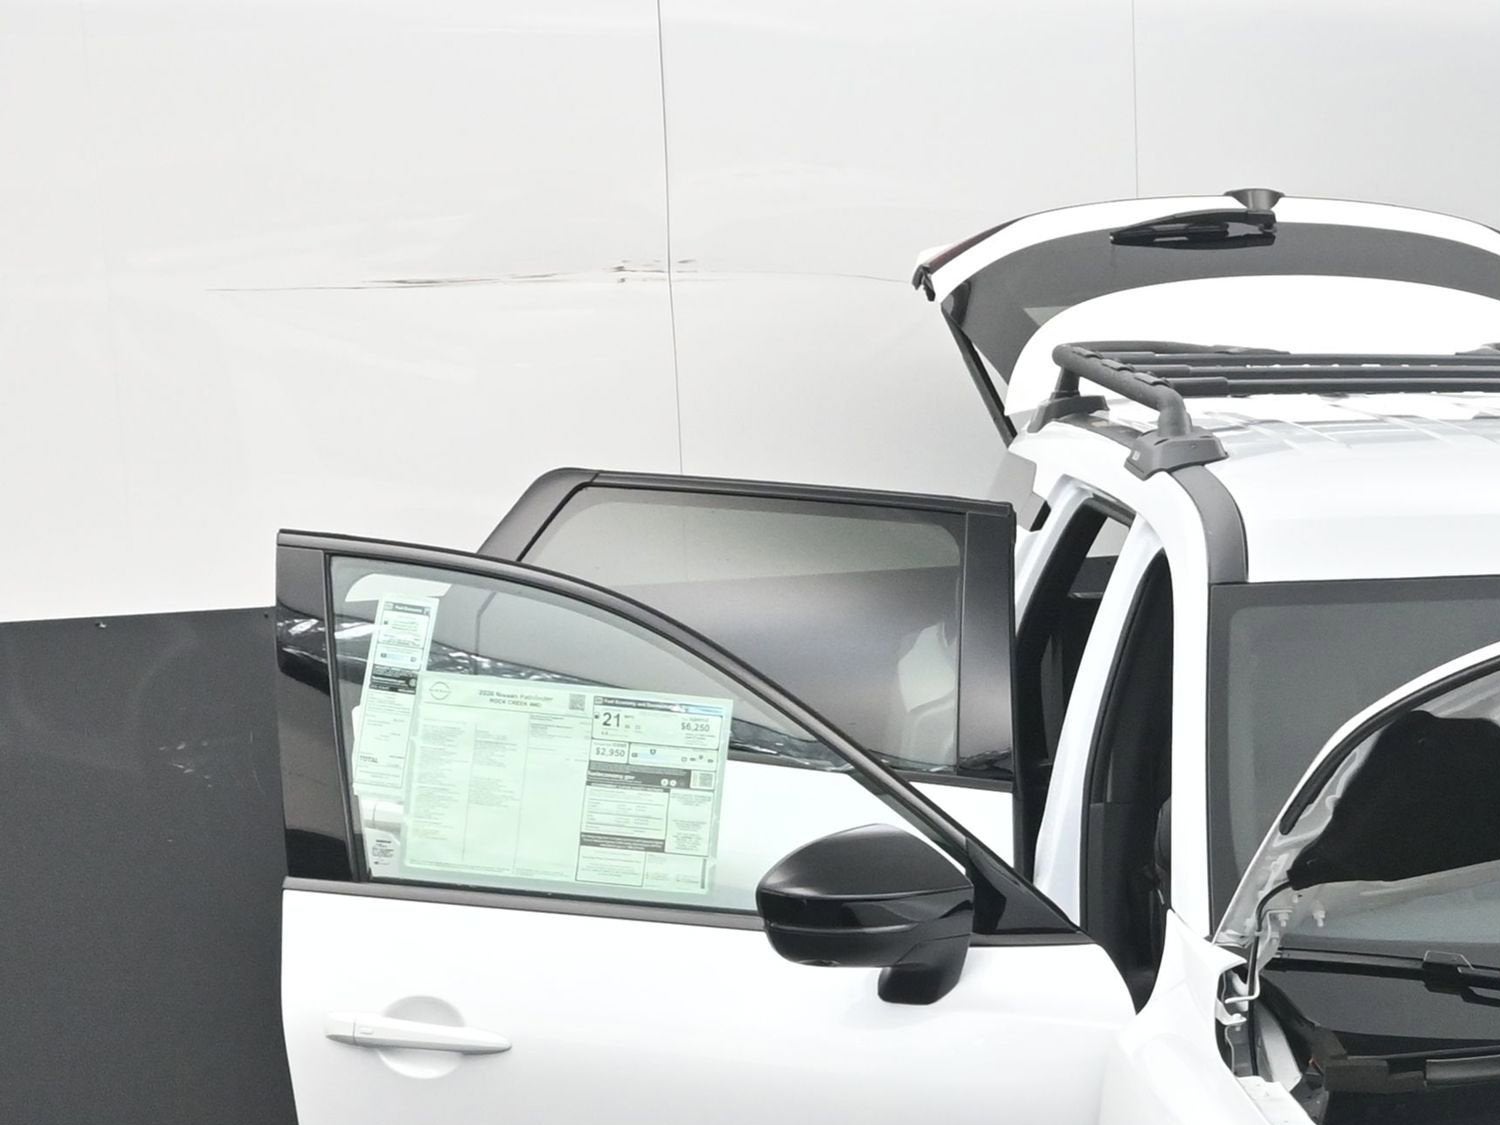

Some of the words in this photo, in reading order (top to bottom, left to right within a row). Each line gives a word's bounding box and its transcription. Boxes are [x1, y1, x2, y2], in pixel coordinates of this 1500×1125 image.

[602, 711, 620, 727] 21
[681, 721, 711, 733] $6,250
[595, 746, 626, 758] $2,950
